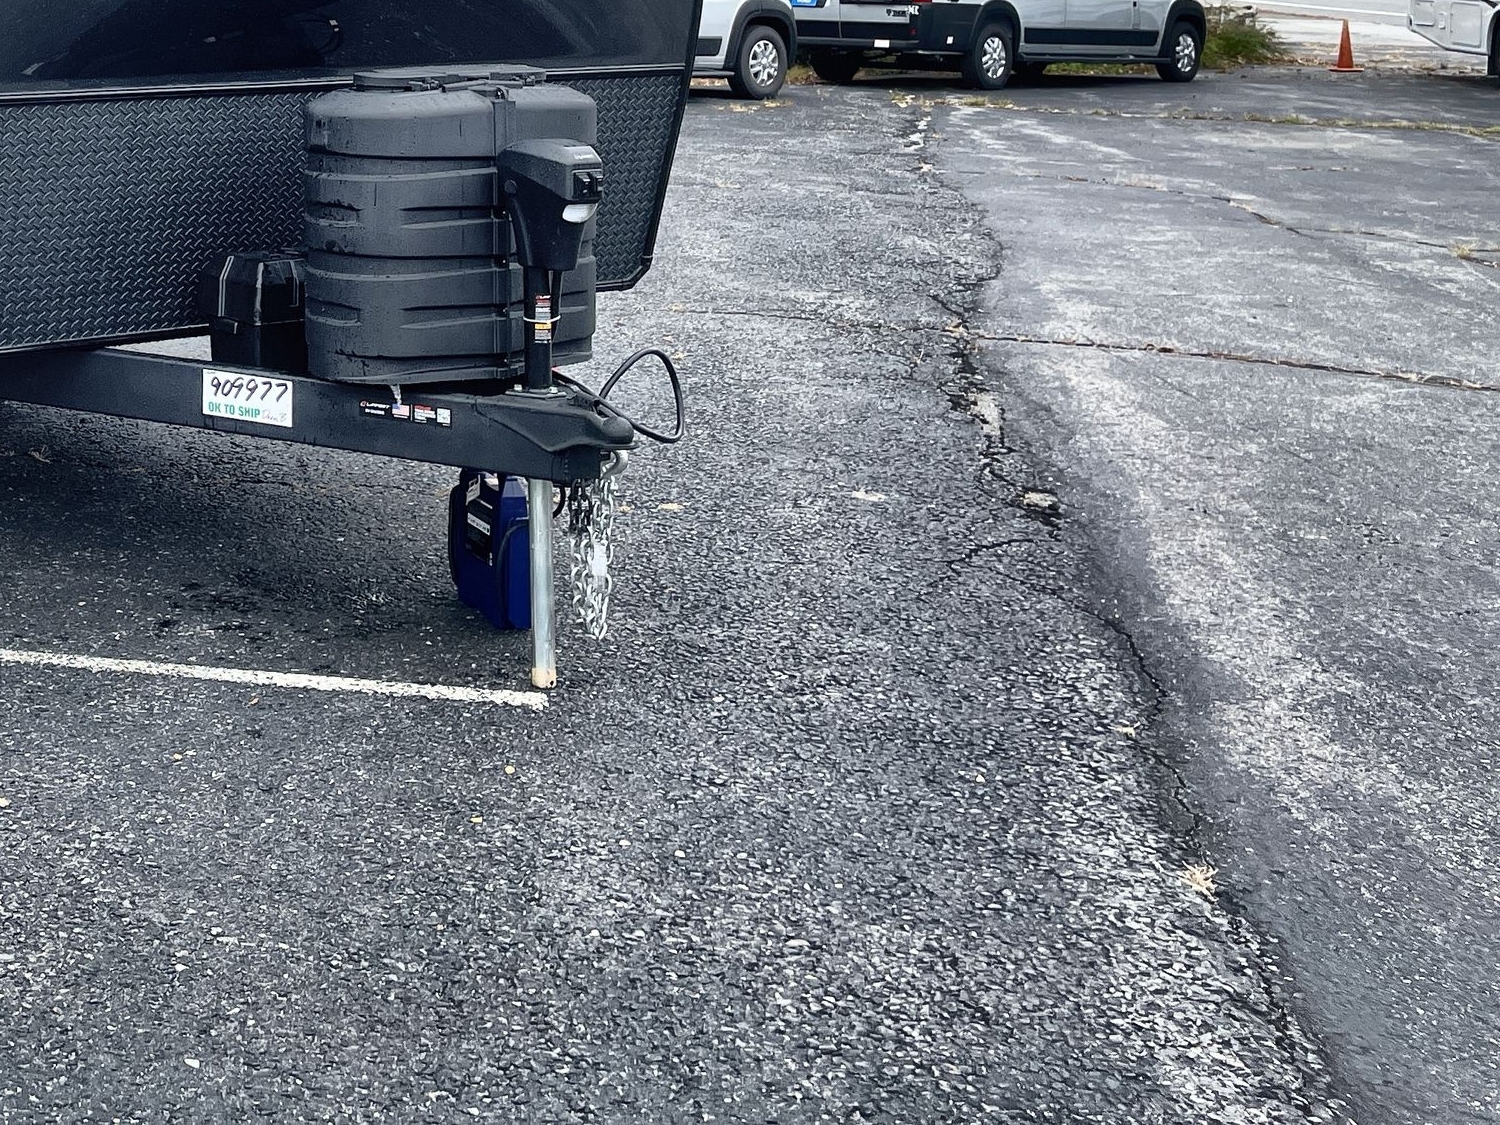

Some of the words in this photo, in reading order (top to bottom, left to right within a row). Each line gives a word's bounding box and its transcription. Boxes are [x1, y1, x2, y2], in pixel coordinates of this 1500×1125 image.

[211, 376, 288, 402] 909977
[208, 401, 221, 413] OK
[224, 403, 235, 415] TO
[238, 406, 260, 418] SHIP
